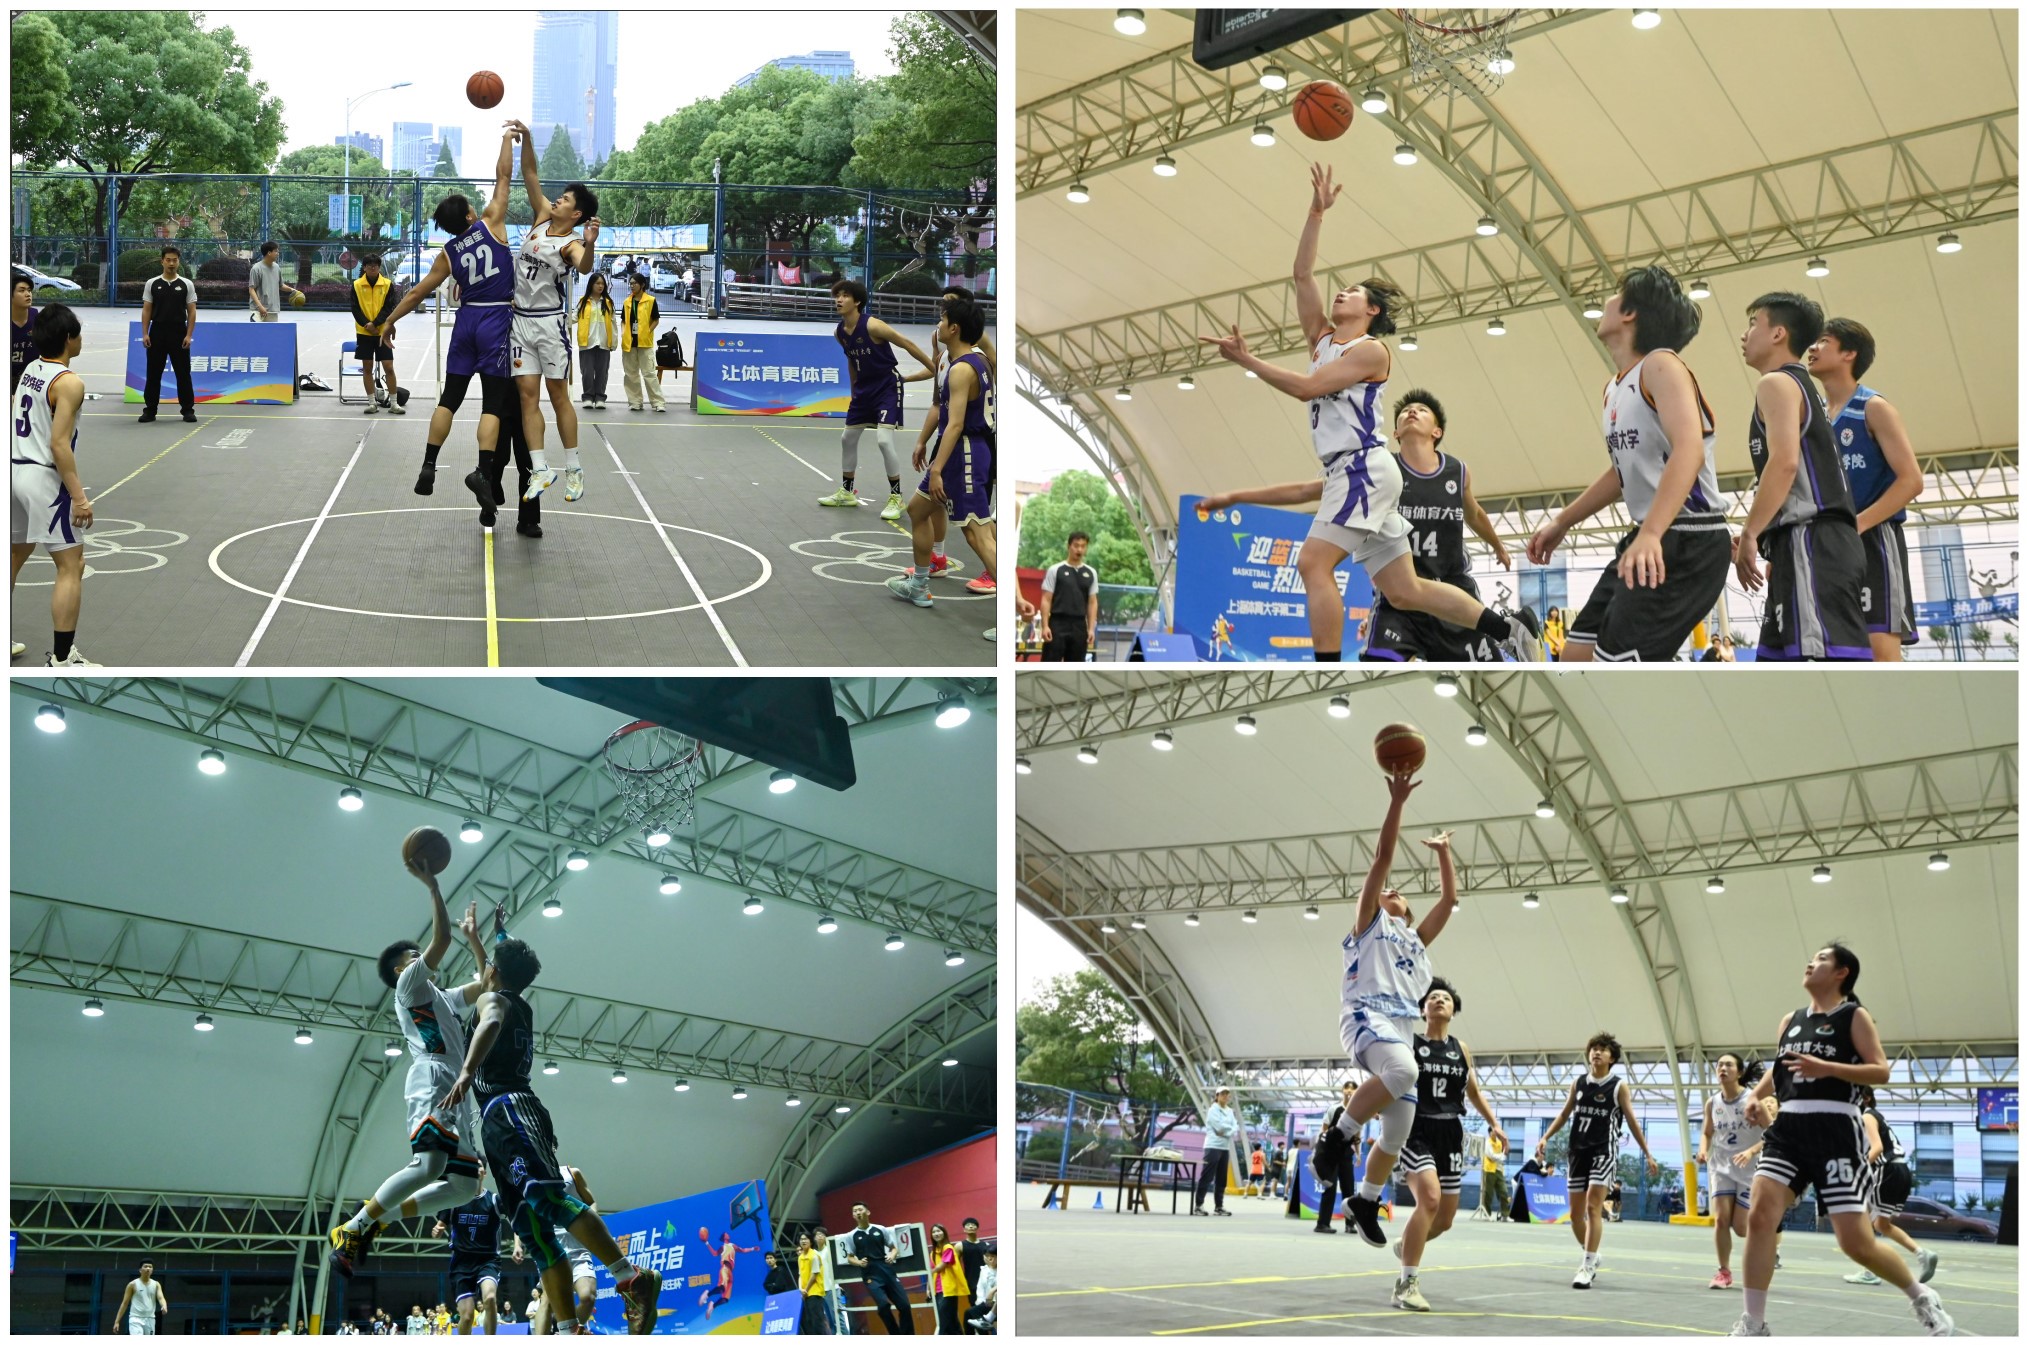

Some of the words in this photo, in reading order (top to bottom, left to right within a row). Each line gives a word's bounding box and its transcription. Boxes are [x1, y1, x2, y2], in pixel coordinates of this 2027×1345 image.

[460, 244, 500, 285] 22
[525, 266, 539, 281] 17
[11, 351, 24, 362] 21
[512, 346, 523, 359] 17
[721, 364, 840, 384] 让体育更体育
[15, 393, 33, 438] 3
[880, 409, 888, 423] 7
[1312, 403, 1320, 430] 3
[1411, 531, 1438, 557] 14
[1232, 567, 1272, 578] BASKETBALL
[1252, 581, 1270, 590] GAME
[1226, 599, 1305, 618] 上海体育大学第二届
[1465, 637, 1494, 662] 14
[1432, 1077, 1448, 1098] 12
[1579, 1116, 1592, 1133] 77
[1727, 1132, 1738, 1145] 2
[1449, 1152, 1463, 1172] 12
[1825, 1157, 1854, 1185] 25
[458, 1213, 490, 1225] SUS
[468, 1226, 476, 1241] 7
[900, 1233, 909, 1249] 9
[840, 1241, 848, 1258] 3
